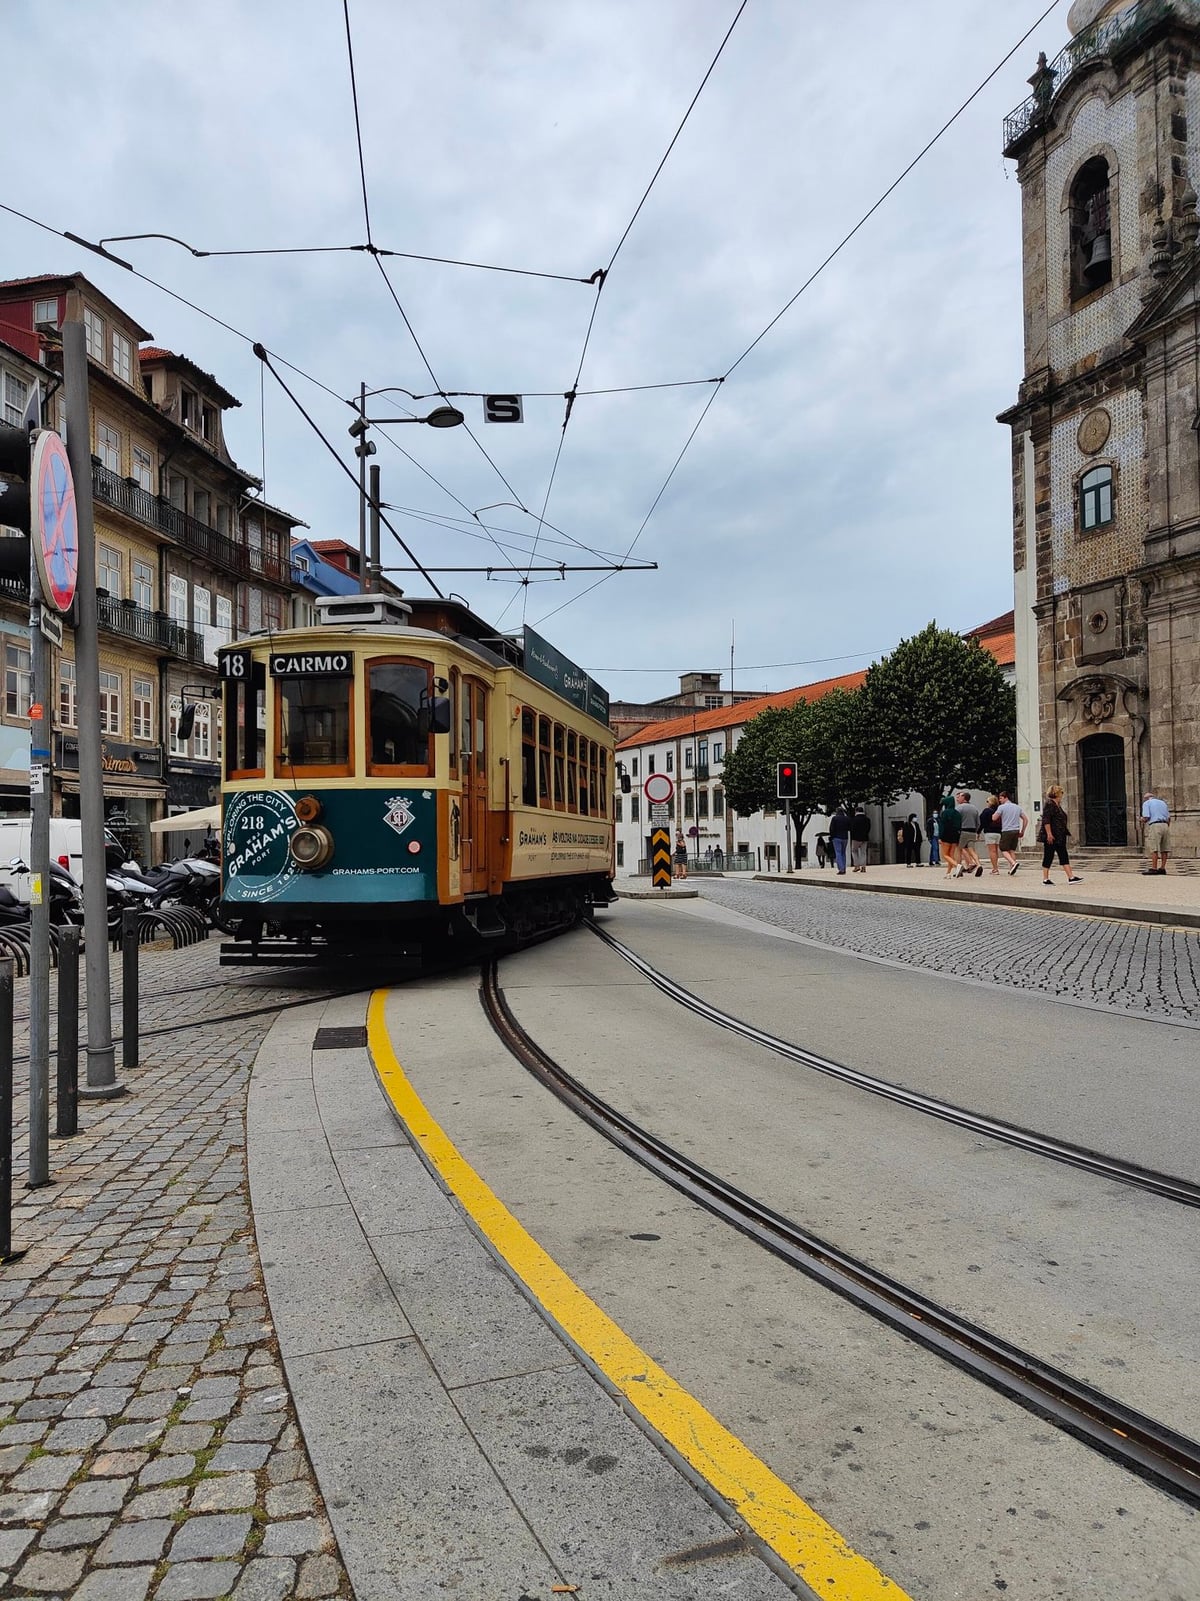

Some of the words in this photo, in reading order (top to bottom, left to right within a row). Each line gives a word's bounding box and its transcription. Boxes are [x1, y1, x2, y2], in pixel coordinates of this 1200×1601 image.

[487, 395, 520, 422] S
[221, 654, 244, 676] 18
[273, 655, 348, 673] CARMO
[226, 799, 247, 856] EXPLORING
[247, 793, 264, 802] THE
[265, 795, 287, 812] CITY
[241, 816, 264, 830] 218
[228, 815, 297, 878] GRAHAM'S
[519, 830, 547, 846] GRAHAM'S
[251, 848, 271, 866] PORT
[241, 884, 274, 898] SINCE
[278, 860, 297, 885] 1820
[332, 867, 420, 876] GRAHAMS-PORT.COM
